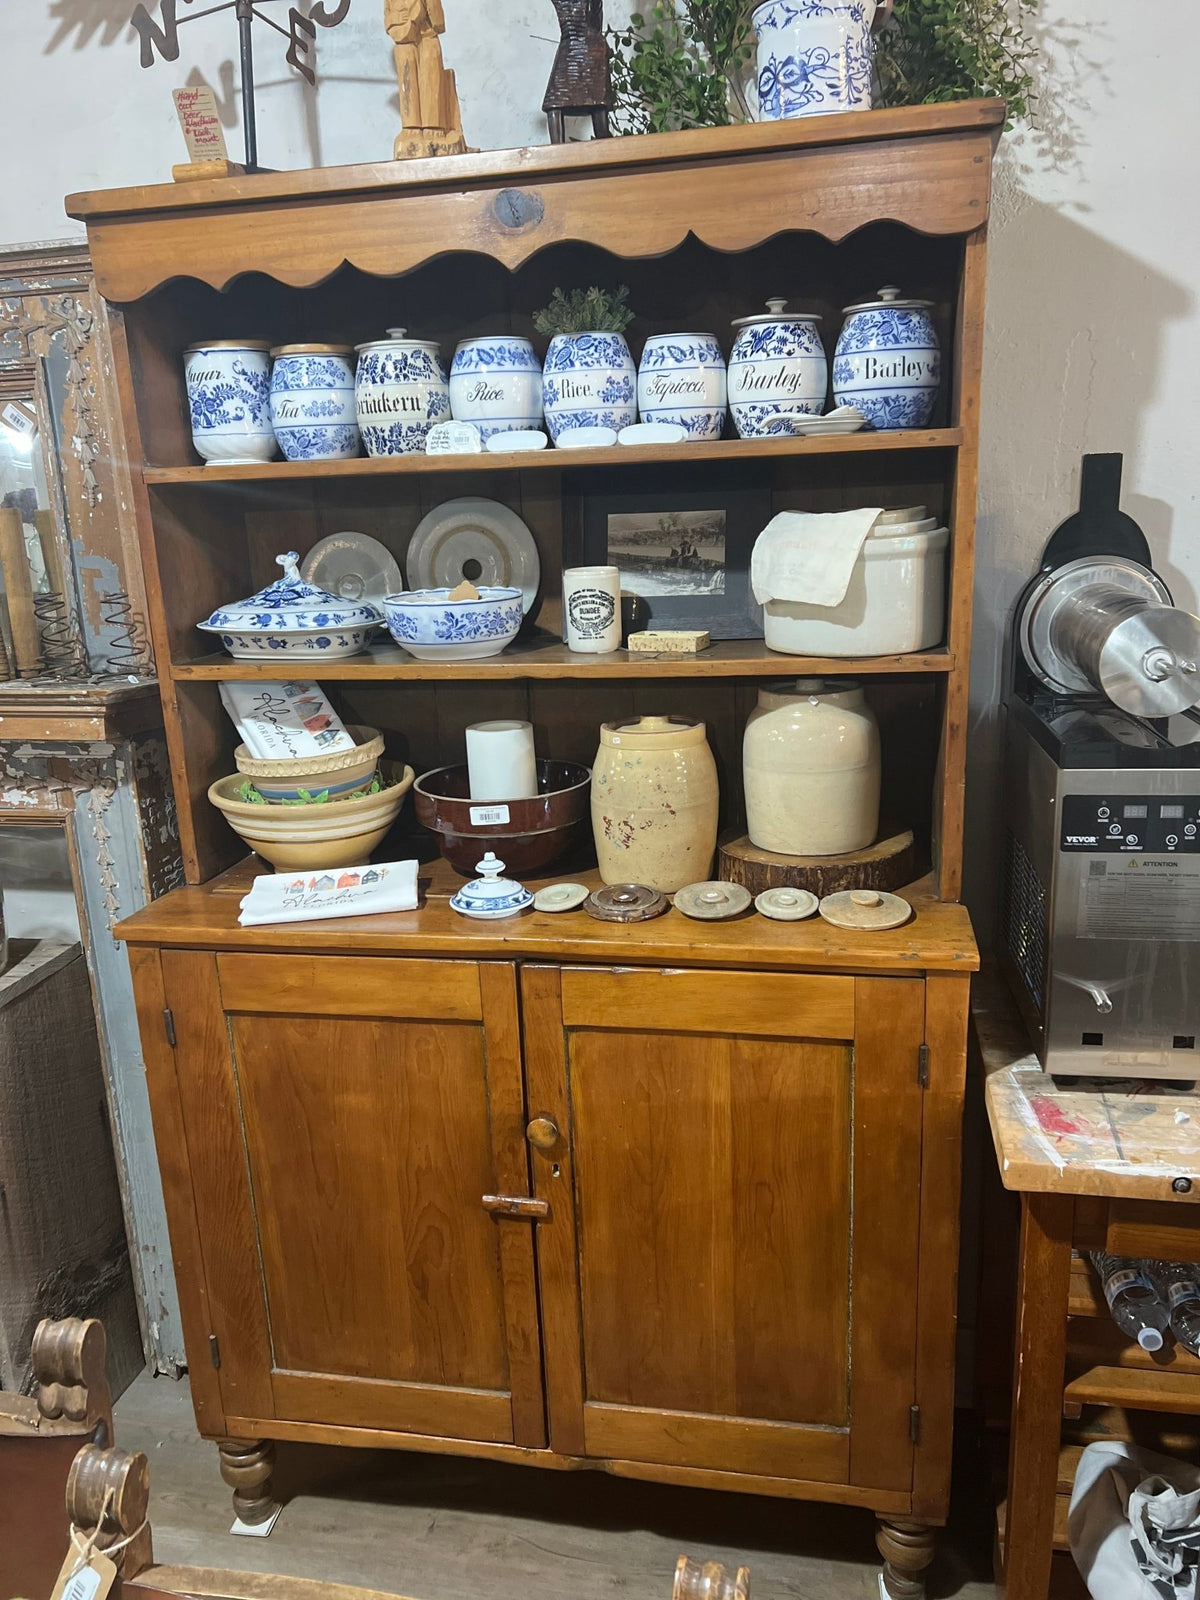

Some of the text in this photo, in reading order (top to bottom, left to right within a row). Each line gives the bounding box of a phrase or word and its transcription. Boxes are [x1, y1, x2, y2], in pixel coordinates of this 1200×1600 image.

[276, 399, 301, 419] Tea
[579, 607, 601, 615] DUNDEE
[251, 714, 277, 749] FLORIDA
